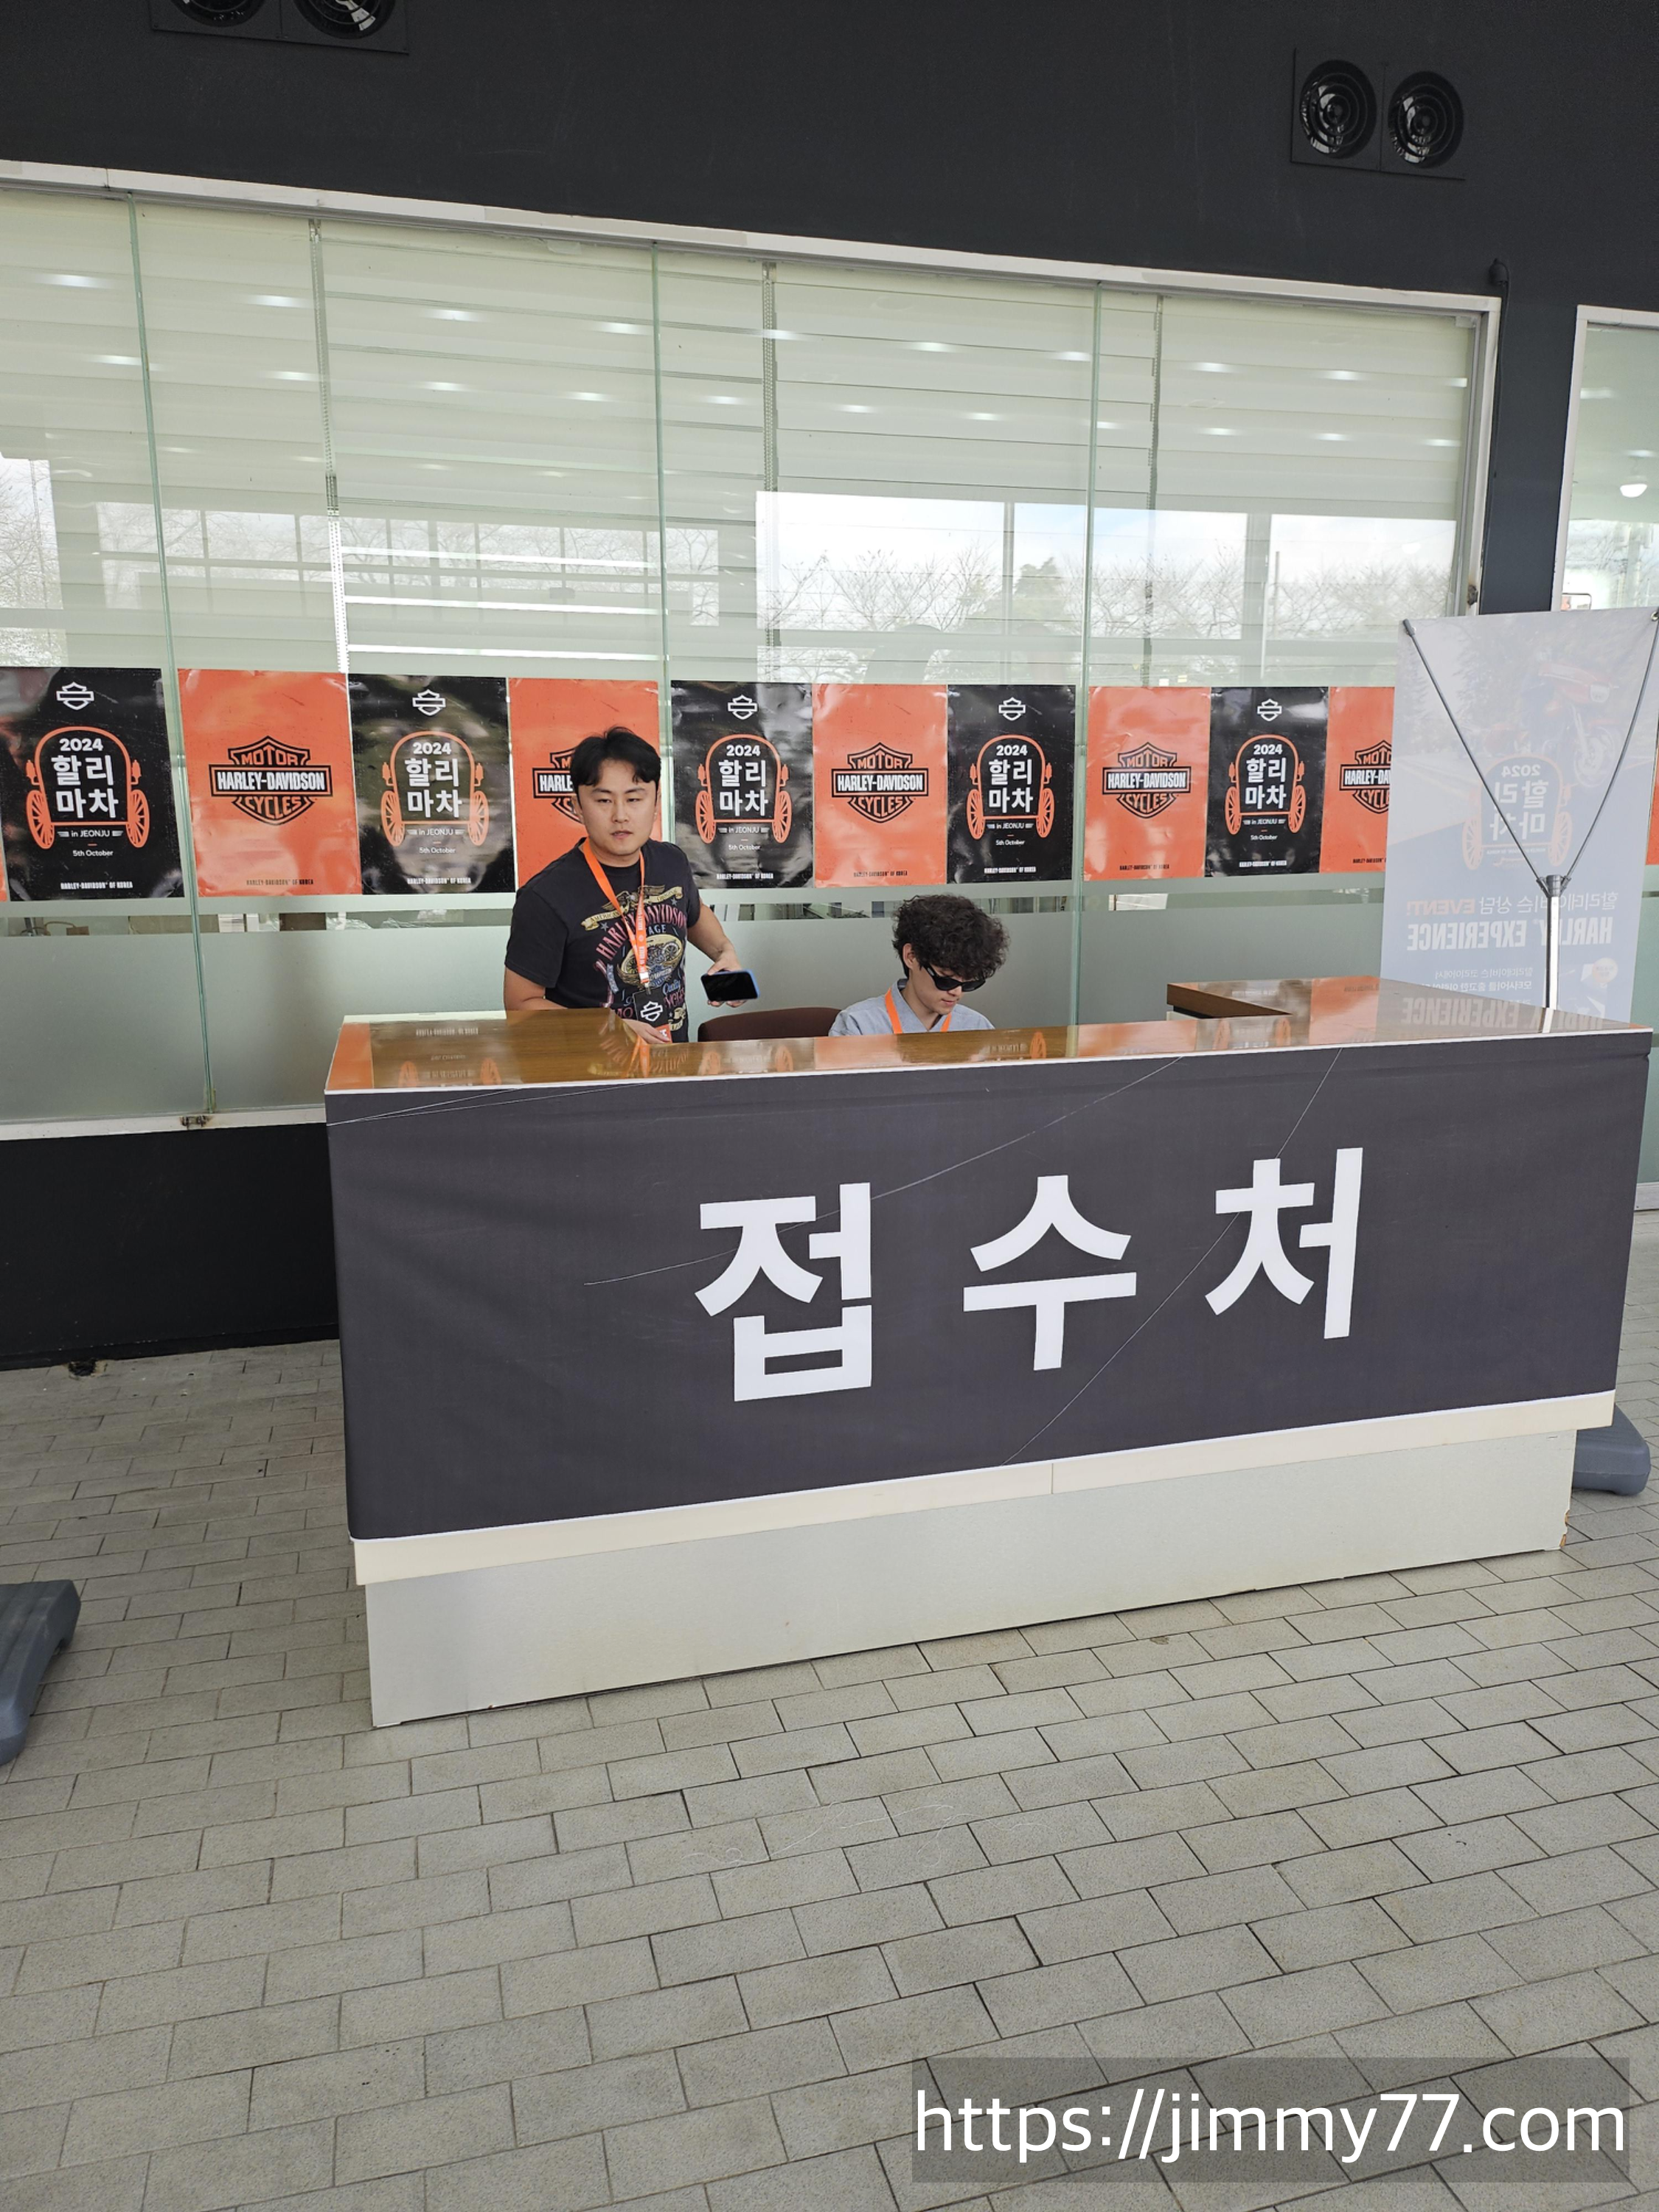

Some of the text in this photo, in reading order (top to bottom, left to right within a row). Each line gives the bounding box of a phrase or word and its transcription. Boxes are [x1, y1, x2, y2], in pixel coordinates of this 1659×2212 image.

[59, 738, 104, 751] 2024
[413, 742, 452, 755] 2024
[726, 745, 761, 757] 2024
[996, 745, 1028, 756] 2024
[1253, 744, 1283, 755] 2024
[240, 745, 299, 766] MOTOR
[858, 751, 903, 769] MOTOR
[1127, 750, 1168, 768] MOTOR
[1363, 749, 1392, 765] MOTO
[51, 755, 114, 786] 할리
[405, 758, 459, 787] 할리
[718, 759, 766, 787] 할리
[988, 759, 1032, 785] 할리
[1246, 757, 1287, 783] 할리
[217, 771, 325, 790] HARLEY-DAVIDSON
[837, 774, 923, 792] HARLEY-DAVIDSON
[1107, 772, 1186, 789] HARLEY-DAVIDSON
[55, 788, 119, 818] 마차
[407, 789, 463, 818] 마차
[719, 789, 769, 817] 마차
[858, 796, 903, 818] CYCLES
[989, 787, 1034, 813] 마차
[1125, 793, 1168, 813] CYCLES
[1245, 785, 1287, 810] 마차
[245, 796, 303, 820] CYCLES
[80, 830, 111, 838] JEONJU
[426, 828, 454, 836] JEONJU
